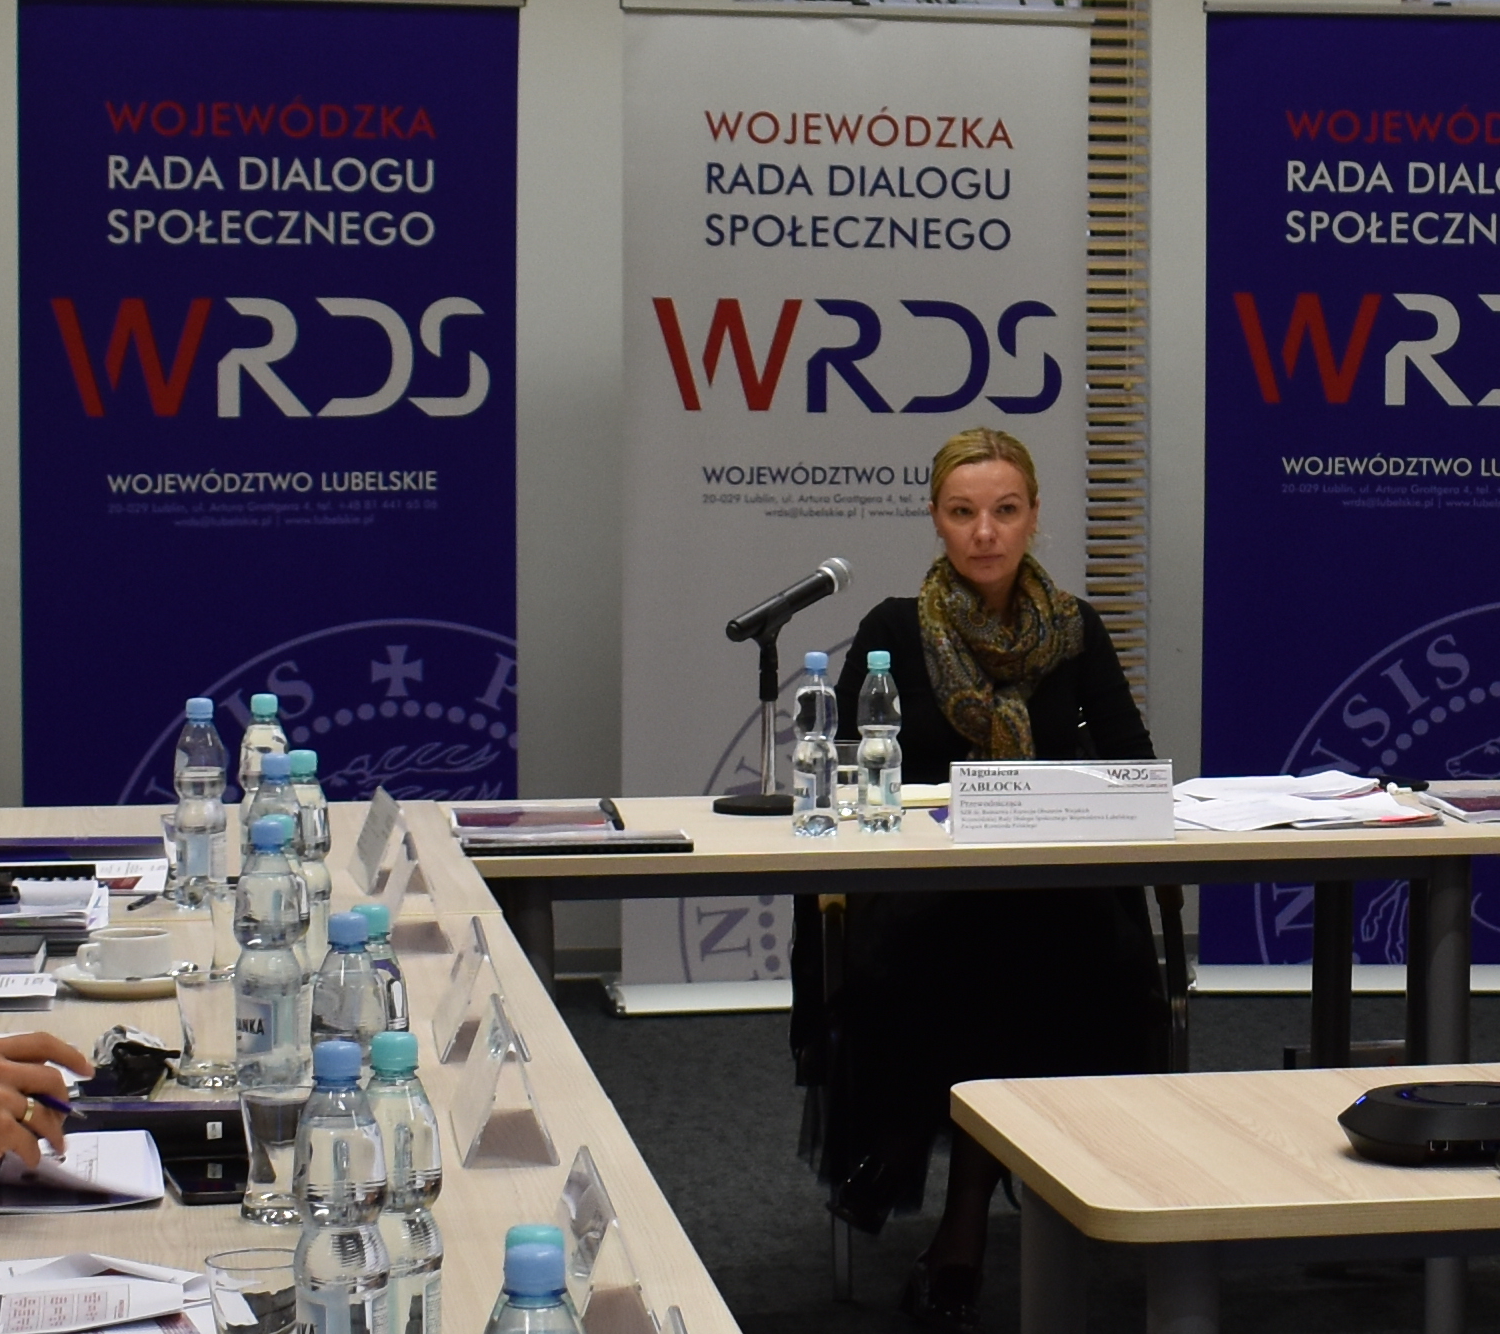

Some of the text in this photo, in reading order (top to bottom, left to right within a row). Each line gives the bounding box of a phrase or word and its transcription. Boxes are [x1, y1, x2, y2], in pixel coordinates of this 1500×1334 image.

[105, 93, 437, 140] WOJEWÓDZKA
[704, 106, 1014, 150] WOJEWÓDZKA
[107, 155, 435, 194] RADA DIALOGU
[706, 162, 1011, 201] RADA DIALOGU
[1287, 159, 1393, 193] RADA
[106, 208, 436, 247] SPOŁECZNEGO
[704, 213, 1011, 251] SPOŁECZNEGO
[50, 295, 491, 418] WRDS
[652, 297, 1063, 414] WRDS
[106, 468, 438, 495] WOJEWÓDZTWO LUBELSKIE
[702, 461, 896, 486] WOJEWÓDZTWO
[1281, 453, 1472, 477] WOJEWÓDZTWO
[1107, 768, 1149, 780] WRDS
